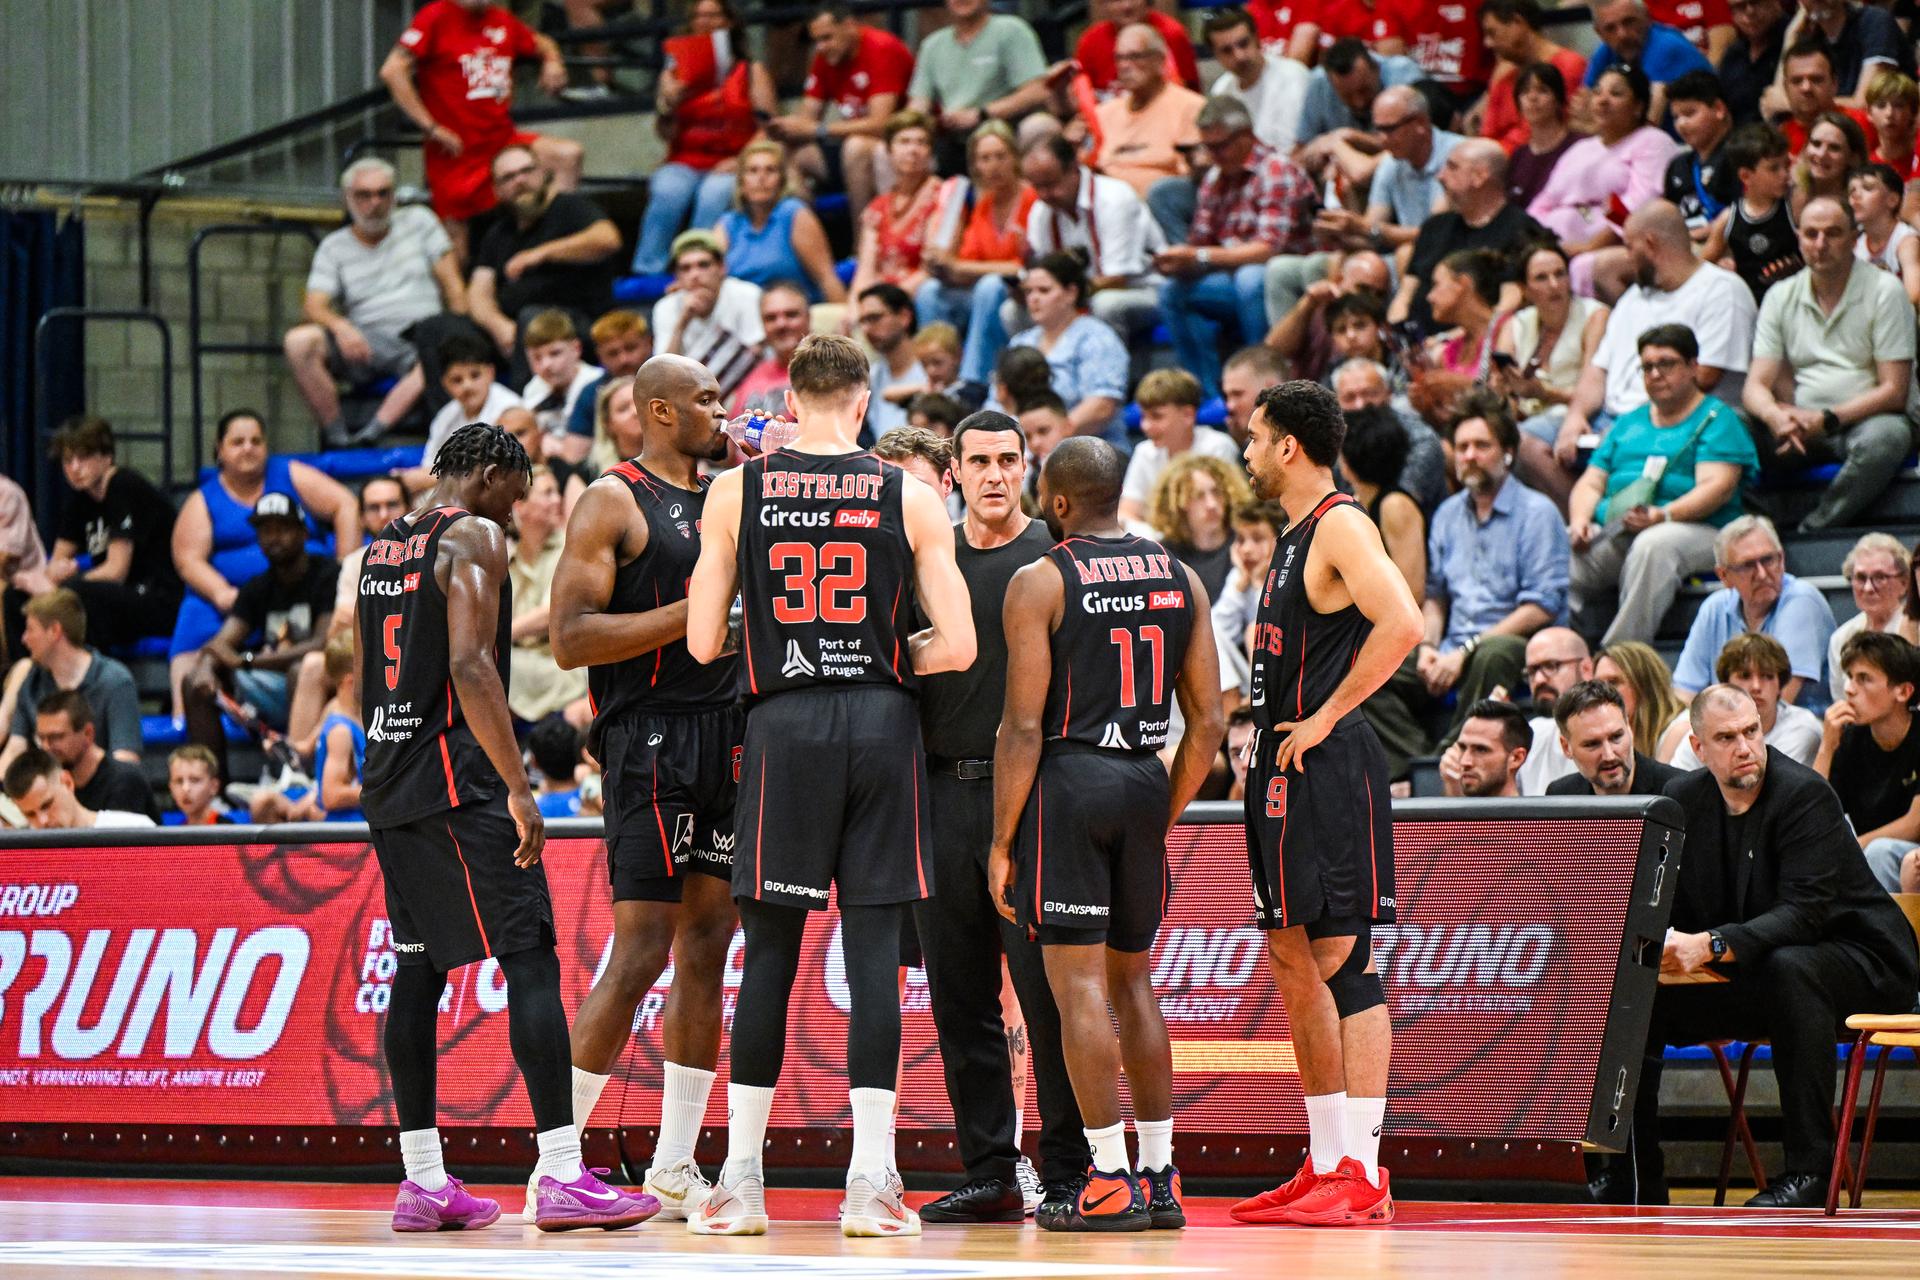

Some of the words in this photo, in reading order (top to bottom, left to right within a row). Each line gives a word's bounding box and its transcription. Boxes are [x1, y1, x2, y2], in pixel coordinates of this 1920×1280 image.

[761, 471, 883, 501] KESTELOOT
[760, 504, 830, 527] Circus
[838, 509, 876, 528] Daily
[1075, 554, 1173, 585] MURRAY
[361, 574, 403, 596] Circus
[769, 542, 866, 623] 32
[1082, 591, 1145, 614] Circus
[1152, 591, 1181, 608] Daily
[383, 614, 403, 691] 5
[819, 638, 844, 650] Port
[848, 639, 862, 650] of
[820, 652, 872, 664] Antwerp
[1110, 625, 1164, 708] 11
[823, 665, 864, 678] Bruges
[398, 702, 412, 713] of
[1139, 720, 1160, 732] Port
[1160, 719, 1169, 730] of
[1266, 776, 1288, 817] 9
[0, 884, 79, 916] ROUP
[1055, 903, 1110, 916] PLAYSPORTS
